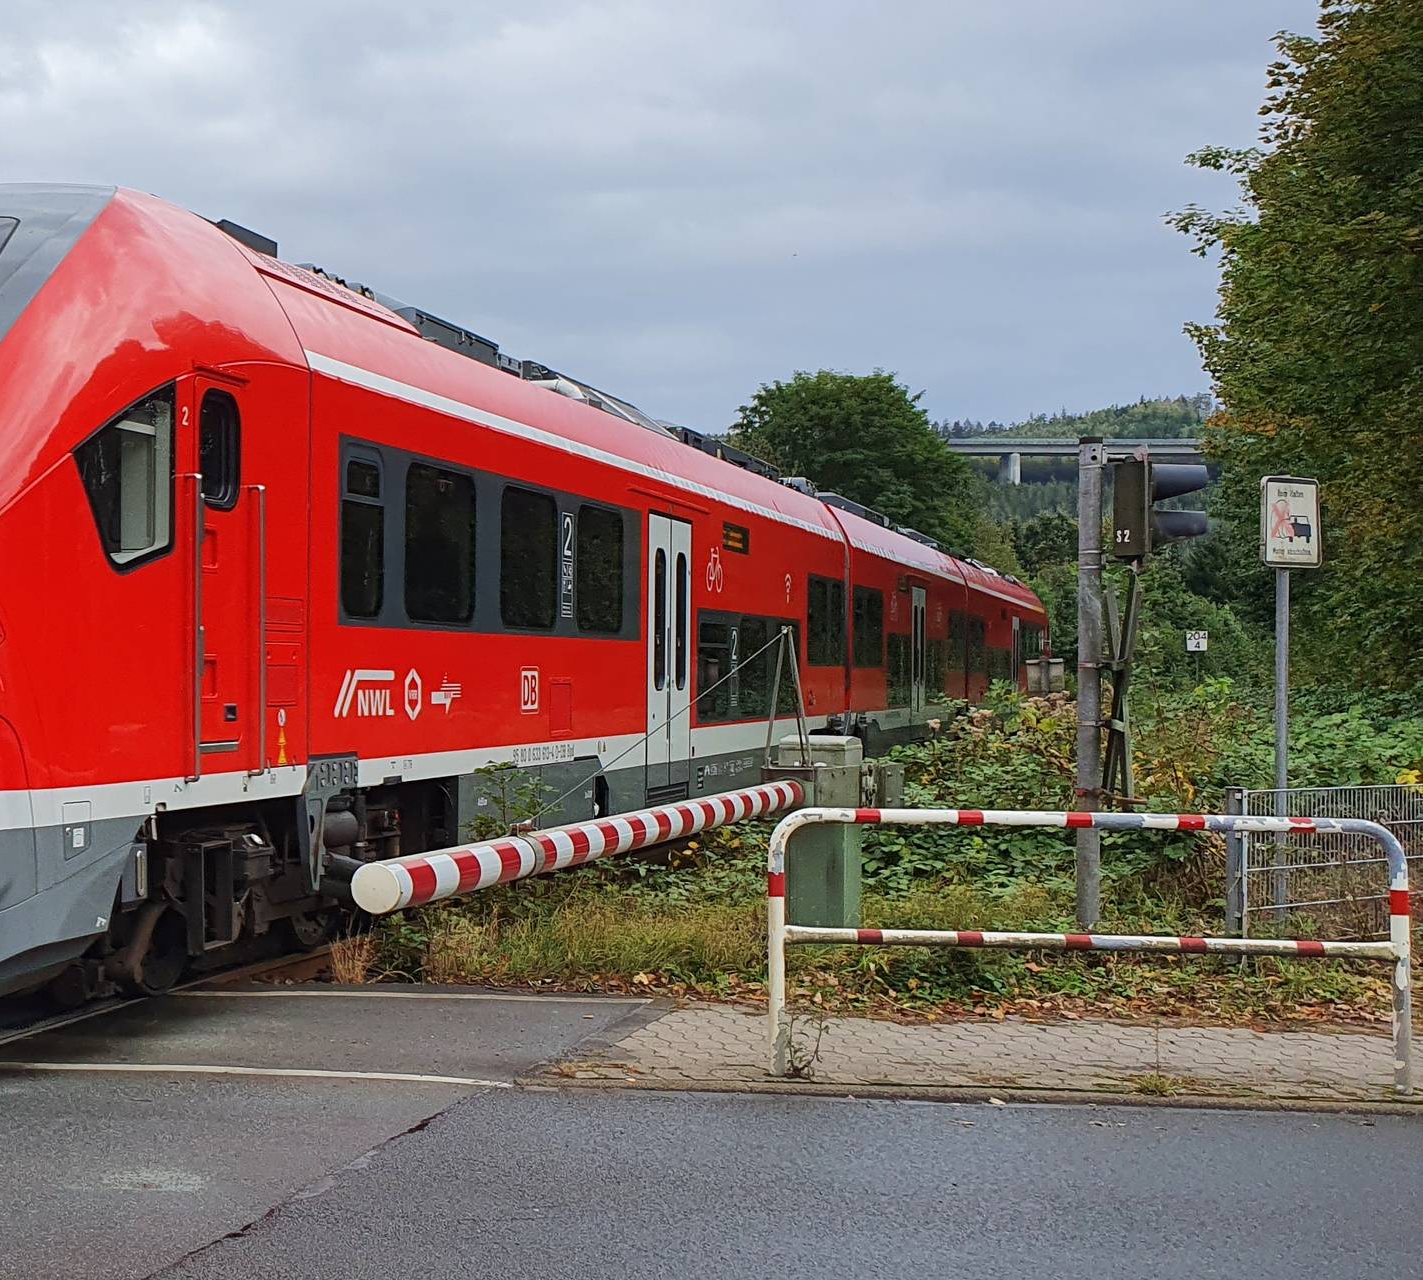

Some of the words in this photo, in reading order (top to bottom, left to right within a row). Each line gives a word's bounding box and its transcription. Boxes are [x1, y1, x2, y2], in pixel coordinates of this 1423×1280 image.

[181, 405, 189, 426] 2
[563, 517, 572, 556] 2
[1187, 631, 1207, 641] 204
[1194, 641, 1201, 649] 4
[522, 674, 537, 706] DB
[357, 689, 395, 717] NWL
